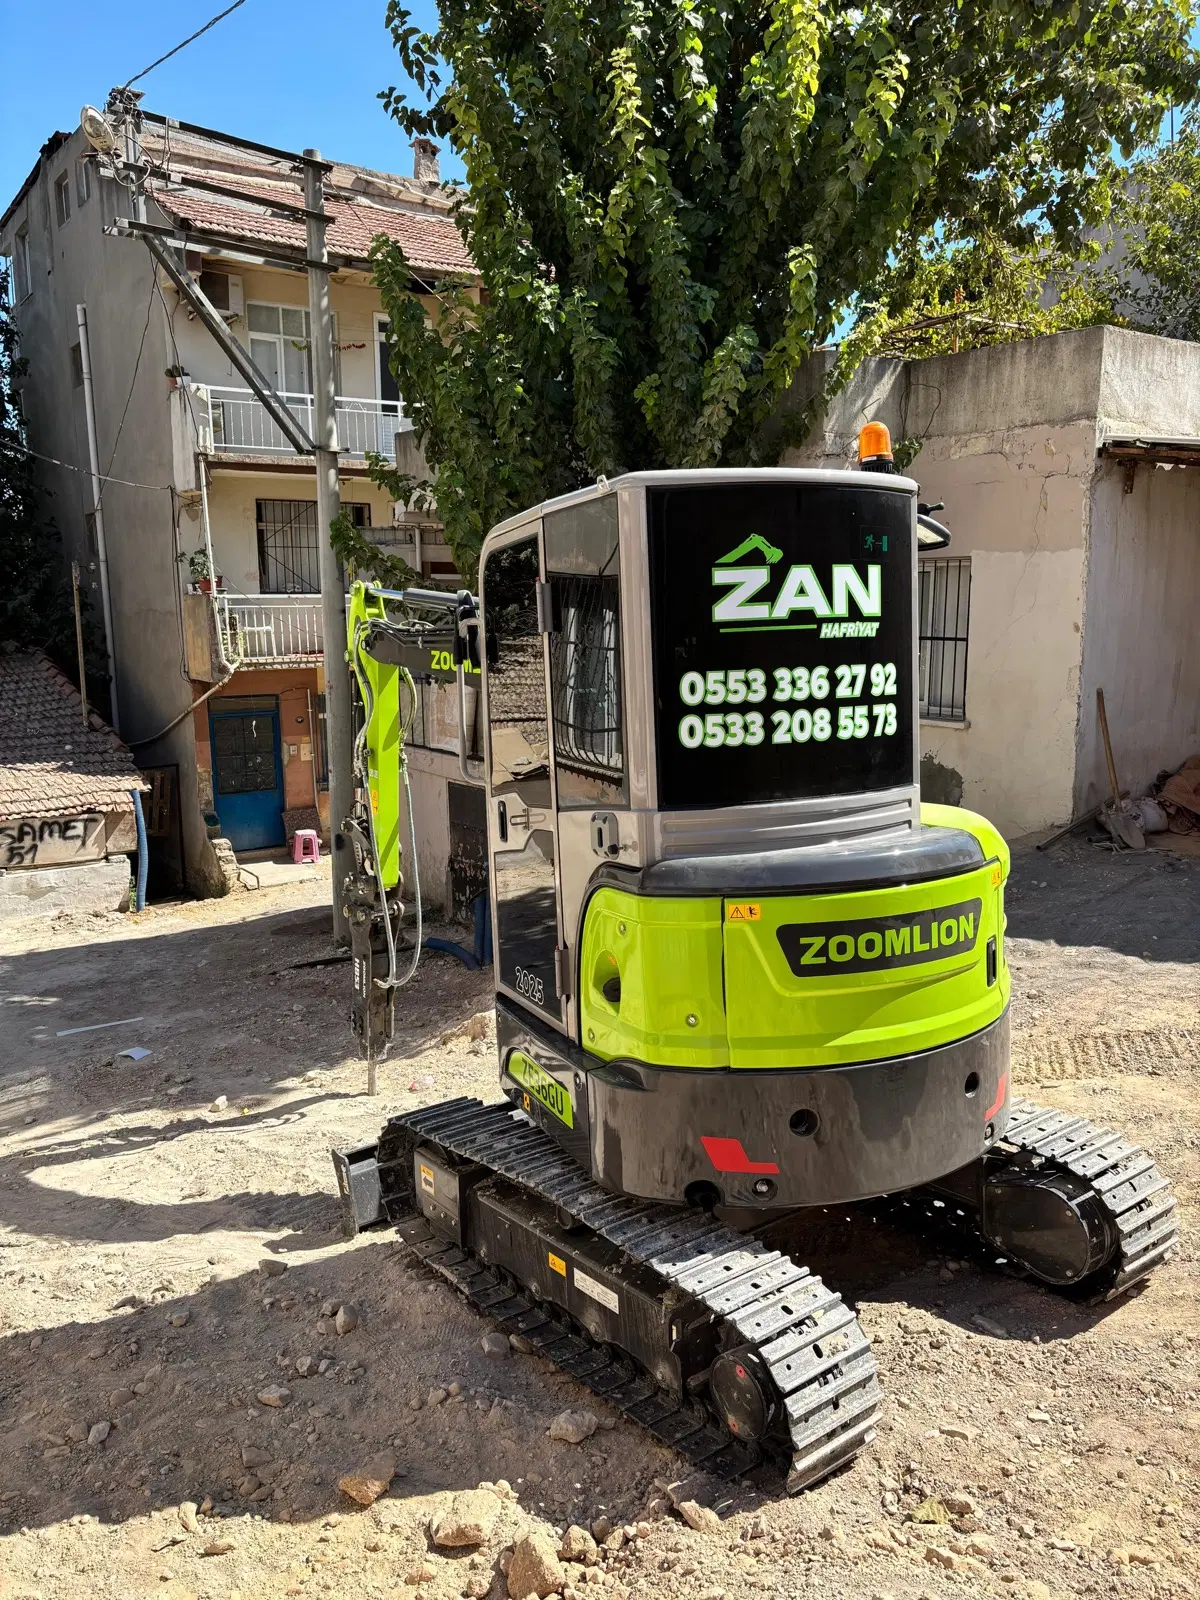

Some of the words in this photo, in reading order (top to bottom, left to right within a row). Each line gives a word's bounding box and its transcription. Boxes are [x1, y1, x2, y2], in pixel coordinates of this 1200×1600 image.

[712, 564, 882, 622] ZAN
[820, 621, 880, 638] HAFRİYAT
[679, 667, 767, 706] 0553
[772, 665, 830, 702] 336
[834, 664, 867, 698] 27
[870, 662, 897, 696] 92
[678, 711, 765, 748] 0533
[771, 707, 832, 745] 208
[837, 705, 869, 740] 55
[872, 702, 897, 737] 73
[0, 817, 98, 848] SAMET
[799, 912, 974, 965] ZOOMLION
[515, 965, 545, 1006] 2025
[521, 1057, 564, 1116] ZE36GU
